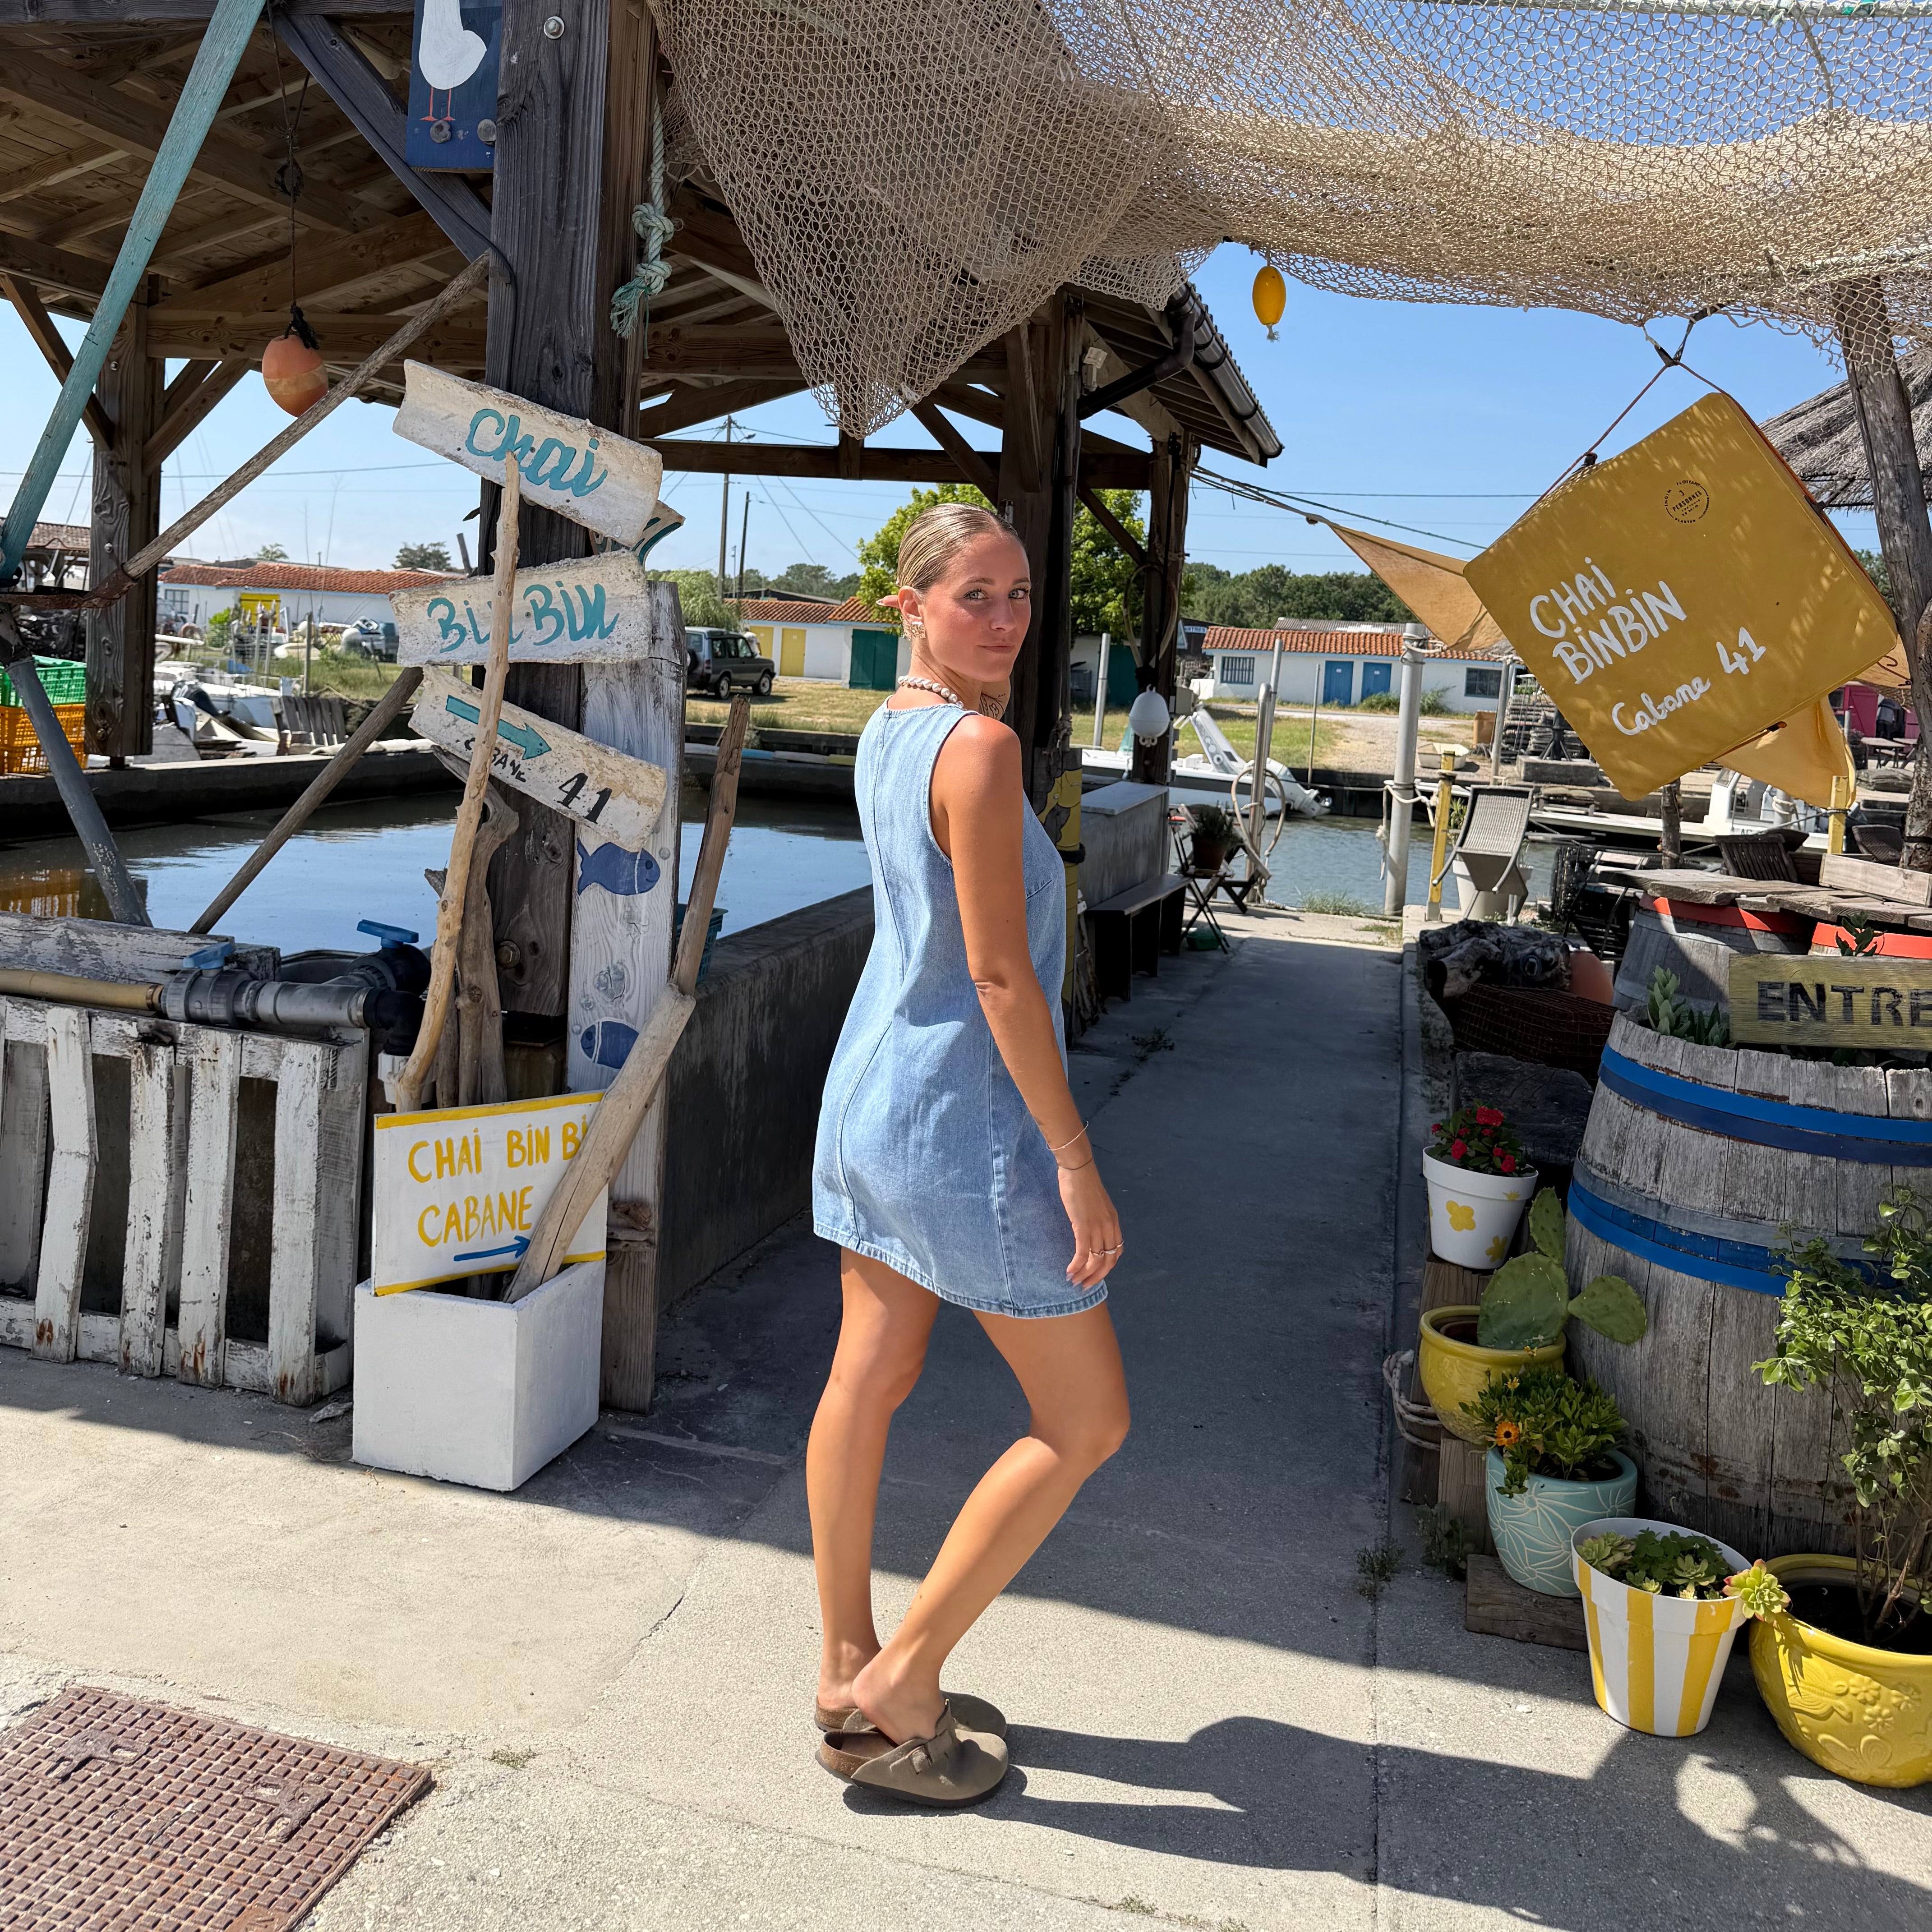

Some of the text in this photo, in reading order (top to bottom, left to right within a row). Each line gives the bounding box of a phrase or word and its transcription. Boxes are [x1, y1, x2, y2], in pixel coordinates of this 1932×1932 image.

[465, 409, 607, 497] Chai
[1672, 490, 1702, 512] PERSONNES
[1612, 627, 1767, 736] Cabane 41
[554, 772, 613, 824] 41
[417, 1185, 534, 1248] CABANE
